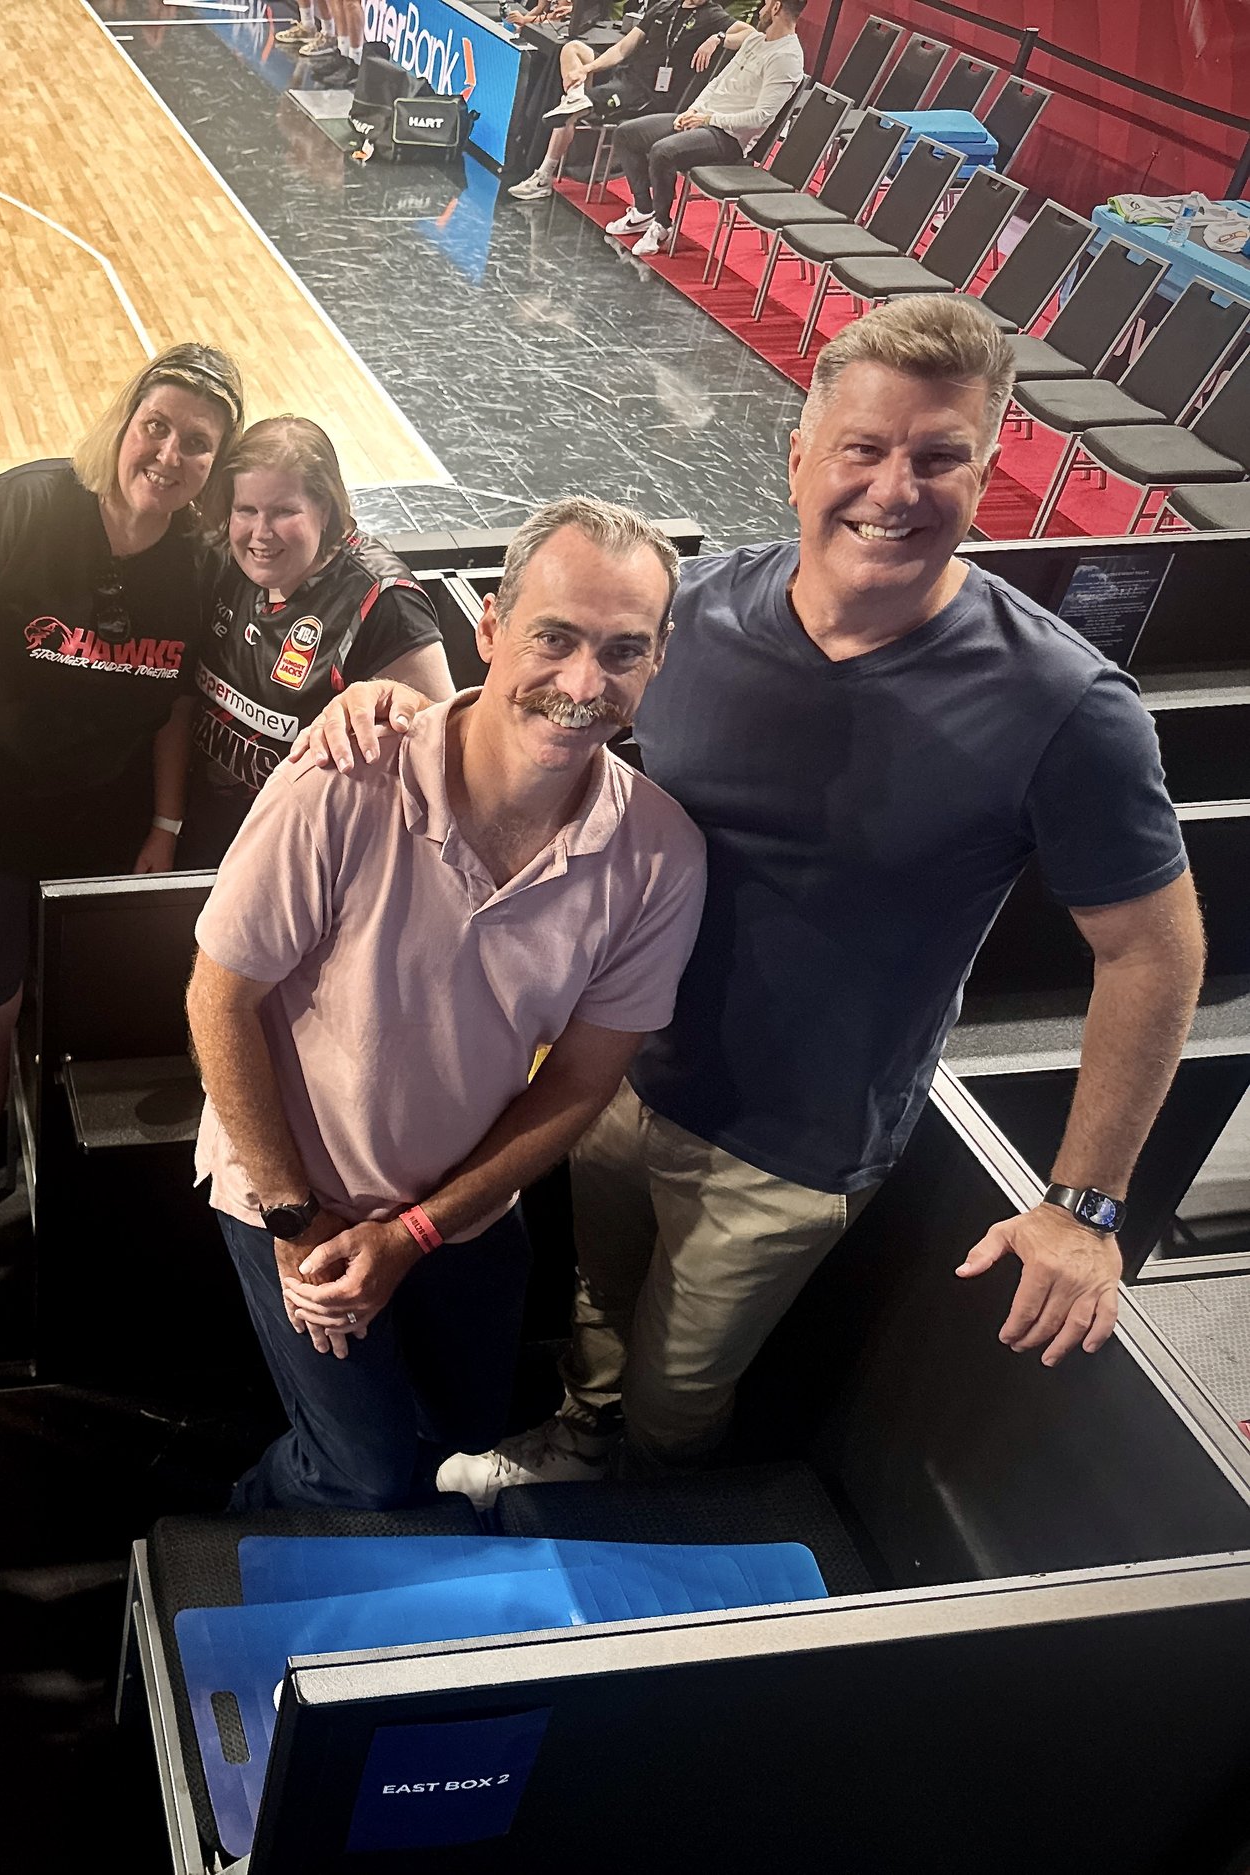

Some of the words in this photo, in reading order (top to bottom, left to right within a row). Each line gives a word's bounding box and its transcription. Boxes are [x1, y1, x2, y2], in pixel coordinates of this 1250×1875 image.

[360, 0, 460, 96] aterBank
[408, 116, 444, 129] HART
[29, 648, 92, 669] STRONGER
[91, 661, 133, 675] LOUDER
[133, 664, 180, 680] TOGETHER
[71, 627, 186, 669] HAWKS
[196, 709, 282, 791] AWKS
[382, 1782, 441, 1795] EAST
[444, 1777, 494, 1792] BOX
[497, 1773, 511, 1785] 2
